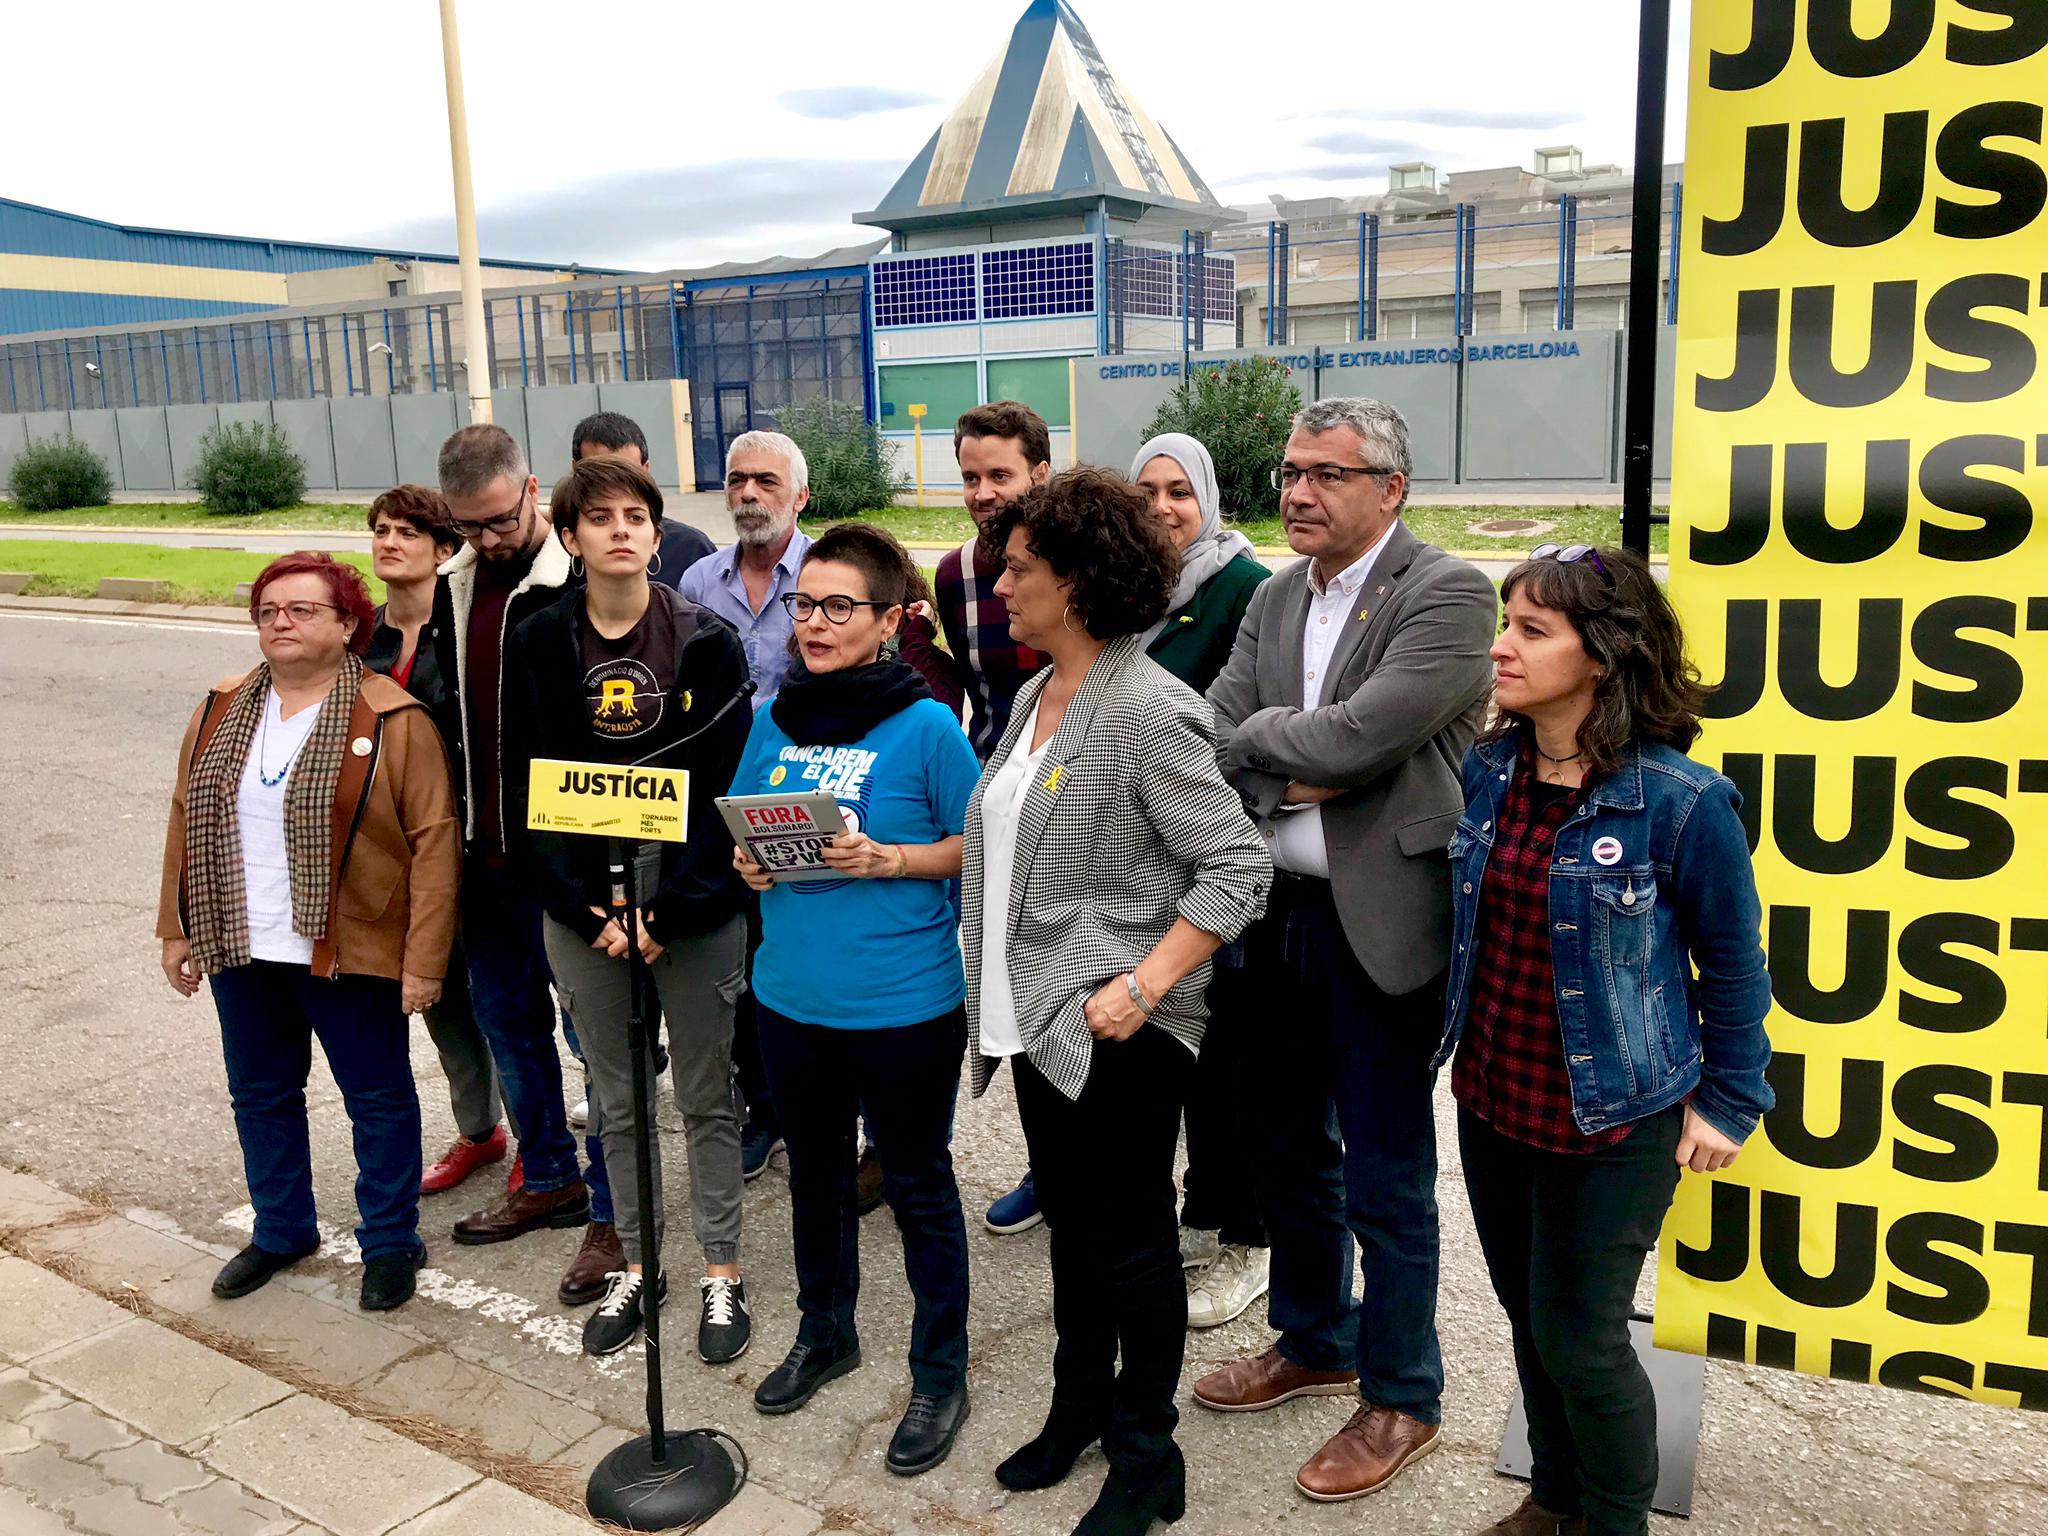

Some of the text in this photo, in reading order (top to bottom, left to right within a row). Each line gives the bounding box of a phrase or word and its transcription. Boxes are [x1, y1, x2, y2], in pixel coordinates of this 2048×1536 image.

[1694, 272, 2048, 412] JUS
[1099, 363, 1158, 379] CENTRO
[1160, 361, 1180, 376] DE
[1313, 354, 1334, 369] DE
[1339, 347, 1463, 368] EXTRANJEROS
[1467, 341, 1580, 362] BARCELONA
[1689, 433, 2048, 565] JUS
[1701, 595, 2048, 723] JUS
[559, 768, 678, 802] JUSTÍCIA
[801, 763, 870, 792] EL CIE
[640, 826, 662, 834] FORTS
[641, 813, 678, 822] TORNAREM
[744, 805, 811, 826] FORA
[752, 822, 814, 834] BOLSONARO!
